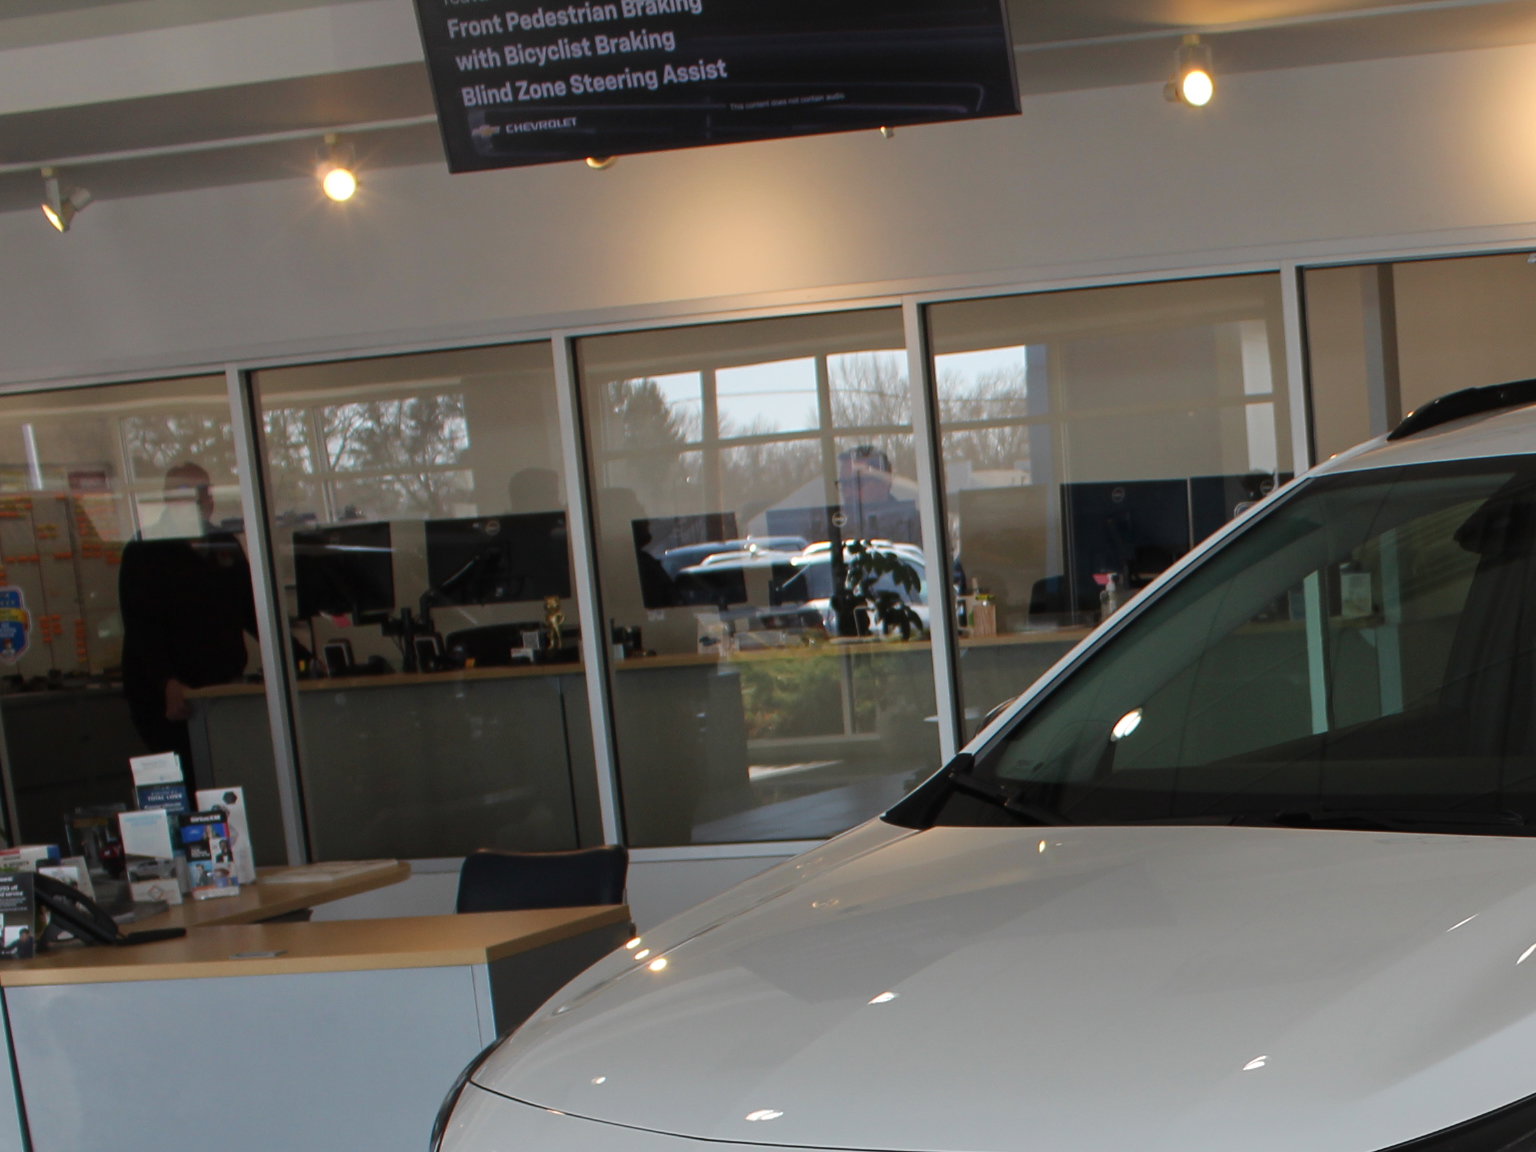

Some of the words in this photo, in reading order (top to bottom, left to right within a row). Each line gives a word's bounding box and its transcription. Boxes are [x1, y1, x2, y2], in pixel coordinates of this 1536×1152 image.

[447, 14, 504, 39] Front
[505, 3, 619, 32] Pedestrian
[620, 0, 703, 19] Braking
[455, 44, 501, 72] with
[504, 37, 592, 67] Bicyclist
[595, 28, 676, 56] Braking
[461, 81, 514, 108] Blind
[515, 78, 567, 101] Zone
[570, 67, 658, 93] Steering
[663, 59, 728, 84] Assist
[787, 97, 799, 105] not
[505, 116, 578, 135] CHEVROLET
